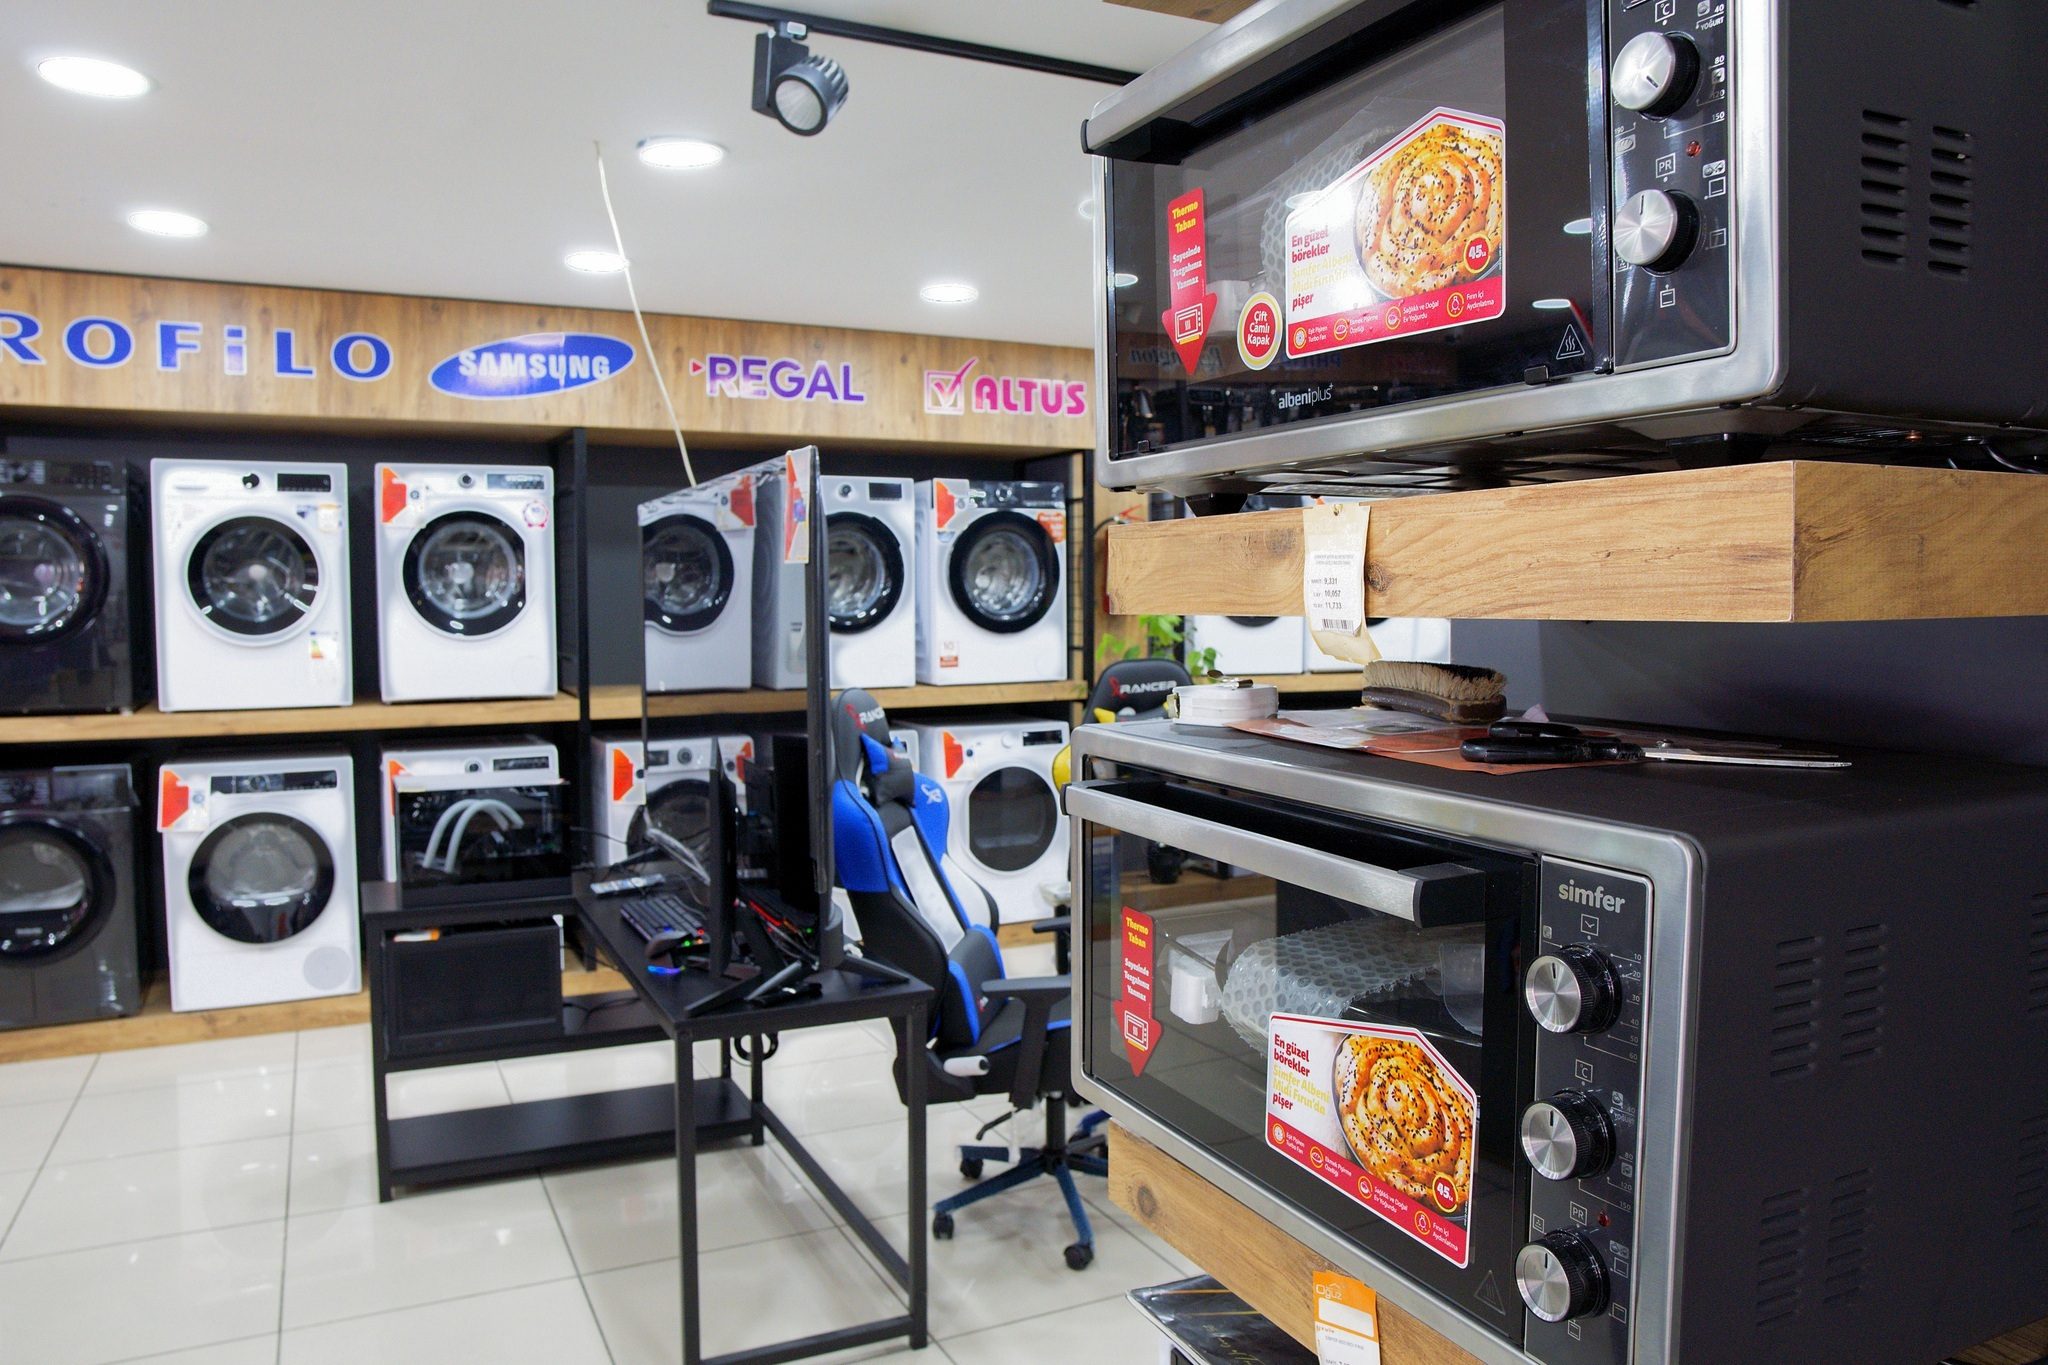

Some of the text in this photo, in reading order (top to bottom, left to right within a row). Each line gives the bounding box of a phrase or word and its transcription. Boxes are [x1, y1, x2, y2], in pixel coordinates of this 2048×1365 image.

[1714, 4, 1725, 13] 40
[1700, 16, 1725, 30] YOĞURT
[1714, 55, 1725, 65] 80
[1712, 111, 1725, 120] 150
[1658, 159, 1673, 173] PR
[1172, 201, 1199, 219] Thermo
[1175, 217, 1196, 233] Taban
[1291, 235, 1303, 247] En
[1291, 243, 1330, 263] börekler
[1292, 293, 1314, 312] pişer
[1253, 310, 1268, 324] Çift
[1249, 322, 1270, 334] Camlı
[1247, 334, 1270, 347] Kapak
[458, 350, 611, 381] SAMSUNG
[706, 354, 866, 405] REGAL
[972, 375, 1088, 418] ALTUS
[1558, 879, 1625, 913] simfer
[1126, 916, 1149, 936] Thermo
[1128, 932, 1146, 948] Taban
[1634, 953, 1642, 962] 10
[1632, 970, 1641, 978] 20
[1631, 994, 1640, 1002] 30
[1630, 1018, 1639, 1026] 40
[1630, 1036, 1639, 1044] 50
[1274, 1033, 1310, 1062] En güzel
[1274, 1048, 1310, 1077] börekler
[1272, 1092, 1293, 1110] pişer
[1624, 1152, 1634, 1160] 80
[1572, 1206, 1584, 1220] PR
